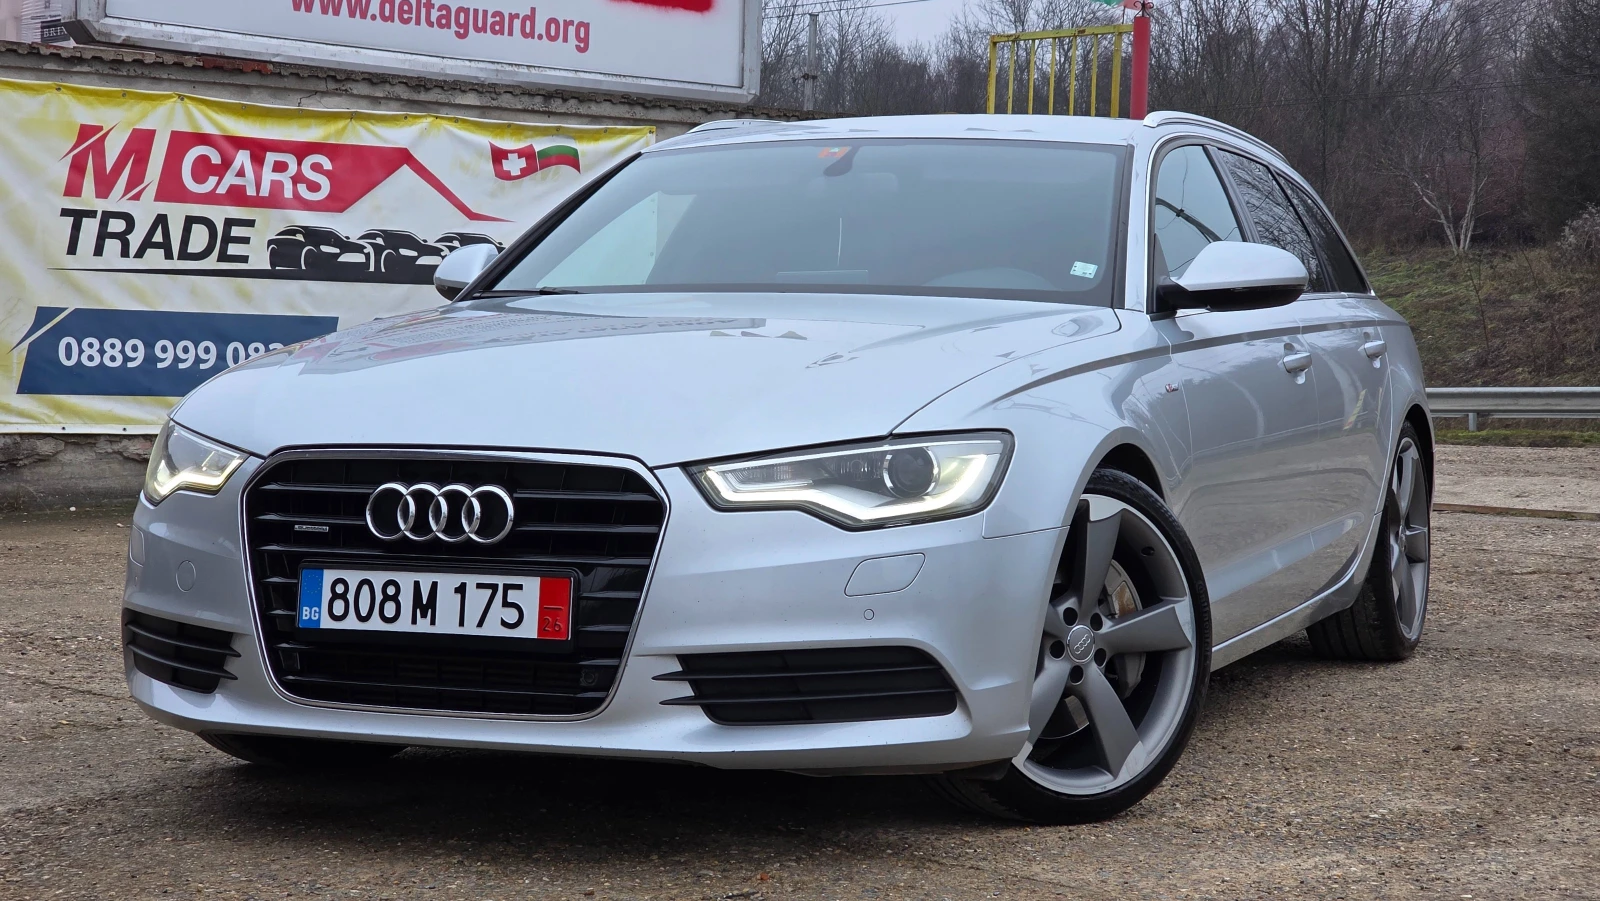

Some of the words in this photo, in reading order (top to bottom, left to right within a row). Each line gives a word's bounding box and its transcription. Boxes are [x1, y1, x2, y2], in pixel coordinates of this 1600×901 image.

[60, 122, 156, 202] M
[181, 145, 332, 200] CARS
[60, 208, 256, 263] TRADE
[58, 336, 145, 367] 0889
[154, 339, 217, 369] 999
[302, 606, 319, 620] BG
[327, 577, 401, 623] 808
[411, 580, 438, 626] M
[453, 581, 525, 629] 175
[543, 616, 562, 632] 26
